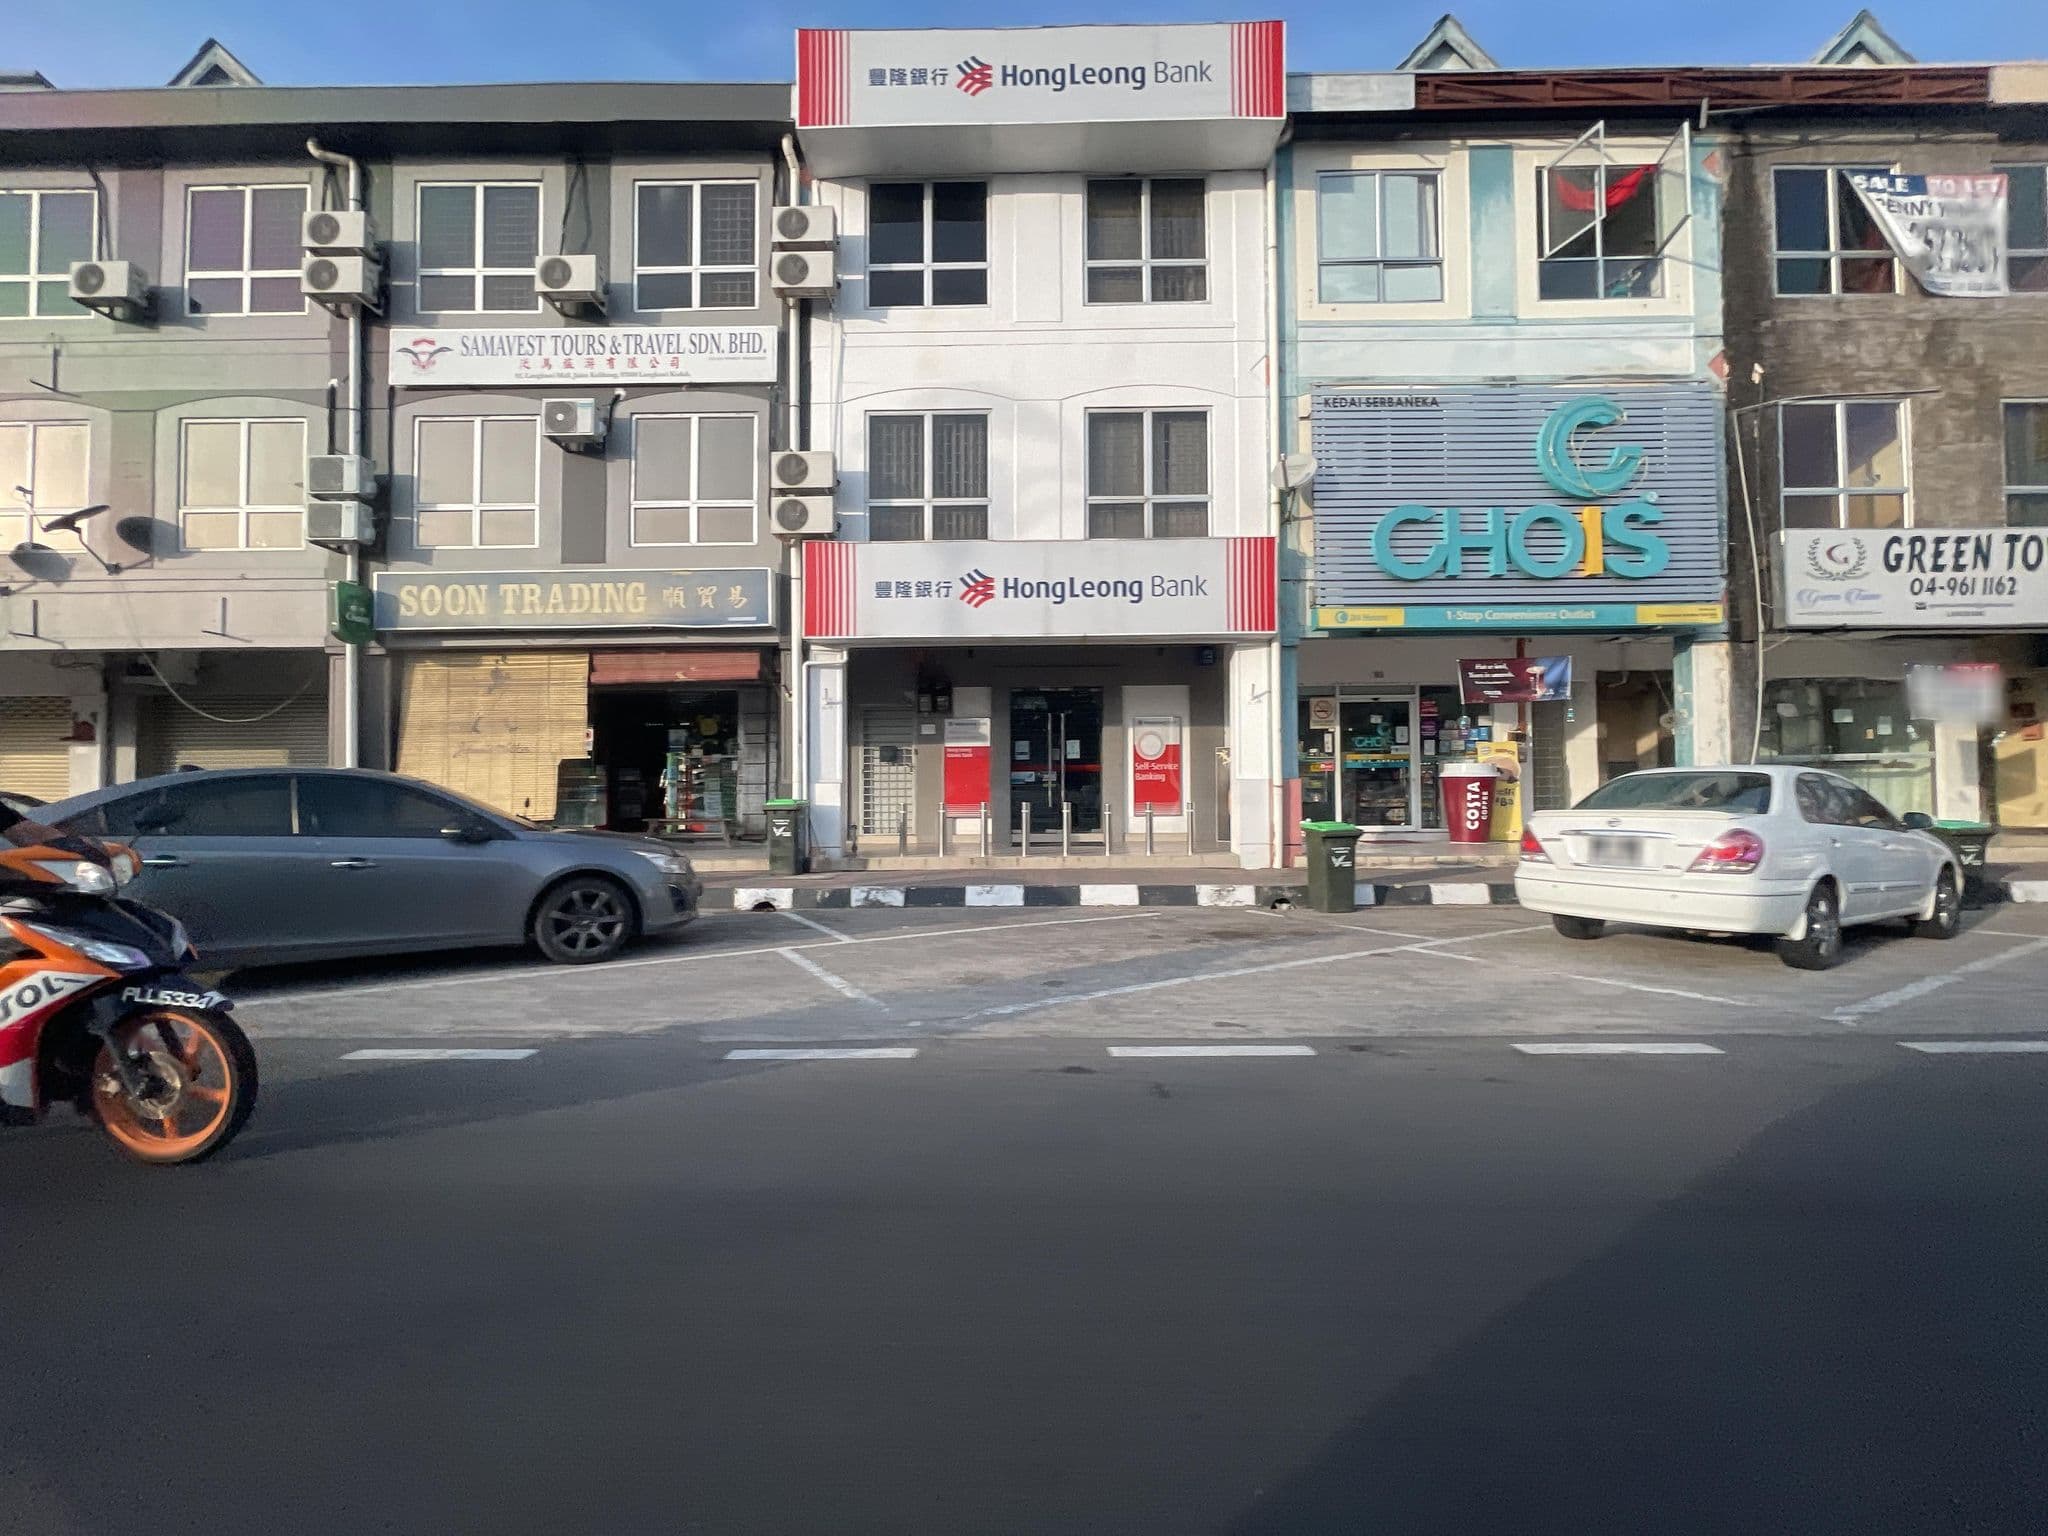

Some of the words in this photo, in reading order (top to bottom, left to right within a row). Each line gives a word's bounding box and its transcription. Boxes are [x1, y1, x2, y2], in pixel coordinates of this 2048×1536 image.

[868, 67, 949, 87] 豐隆銀行
[1001, 63, 1146, 92] HongLeong
[1154, 60, 1212, 84] Bank
[1853, 175, 1909, 192] SALE
[461, 335, 545, 357] SAMAVEST
[551, 334, 606, 356] TOURS
[623, 333, 686, 355] TRAVEL
[689, 333, 725, 354] SDN.
[728, 332, 767, 354] BHD.
[1323, 396, 1363, 408] KEDAI
[1365, 396, 1440, 408] SERBANEKA
[1373, 503, 1671, 580] CHOIS
[1883, 534, 1992, 573] GREEN
[2003, 534, 2048, 571] TO
[400, 584, 488, 616] SOON
[500, 582, 648, 614] TRADING
[874, 580, 953, 598] 豐隆銀行
[1003, 577, 1143, 604] HongLeong
[1151, 574, 1208, 597] Bank
[1910, 577, 1976, 596] 04-961
[1982, 576, 2017, 595] 1162
[1465, 781, 1481, 830] COSTA
